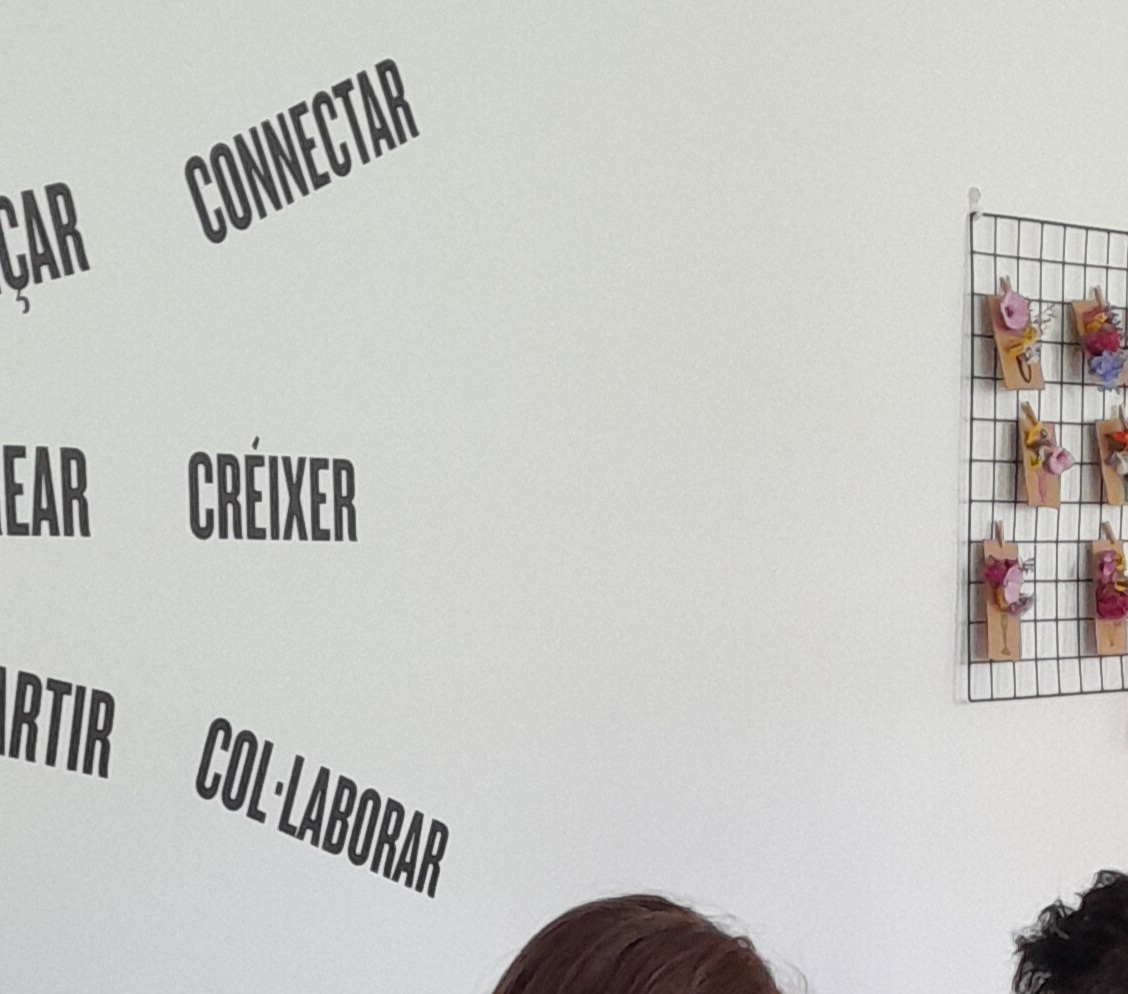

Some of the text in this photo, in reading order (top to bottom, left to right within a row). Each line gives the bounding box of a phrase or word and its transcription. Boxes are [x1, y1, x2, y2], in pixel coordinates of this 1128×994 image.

[184, 58, 420, 244] CONNECTAR
[0, 182, 91, 314] ÇAR
[0, 444, 91, 538] EAR
[188, 436, 358, 542] CRÉIXER
[195, 717, 449, 899] COL·LABORAR
